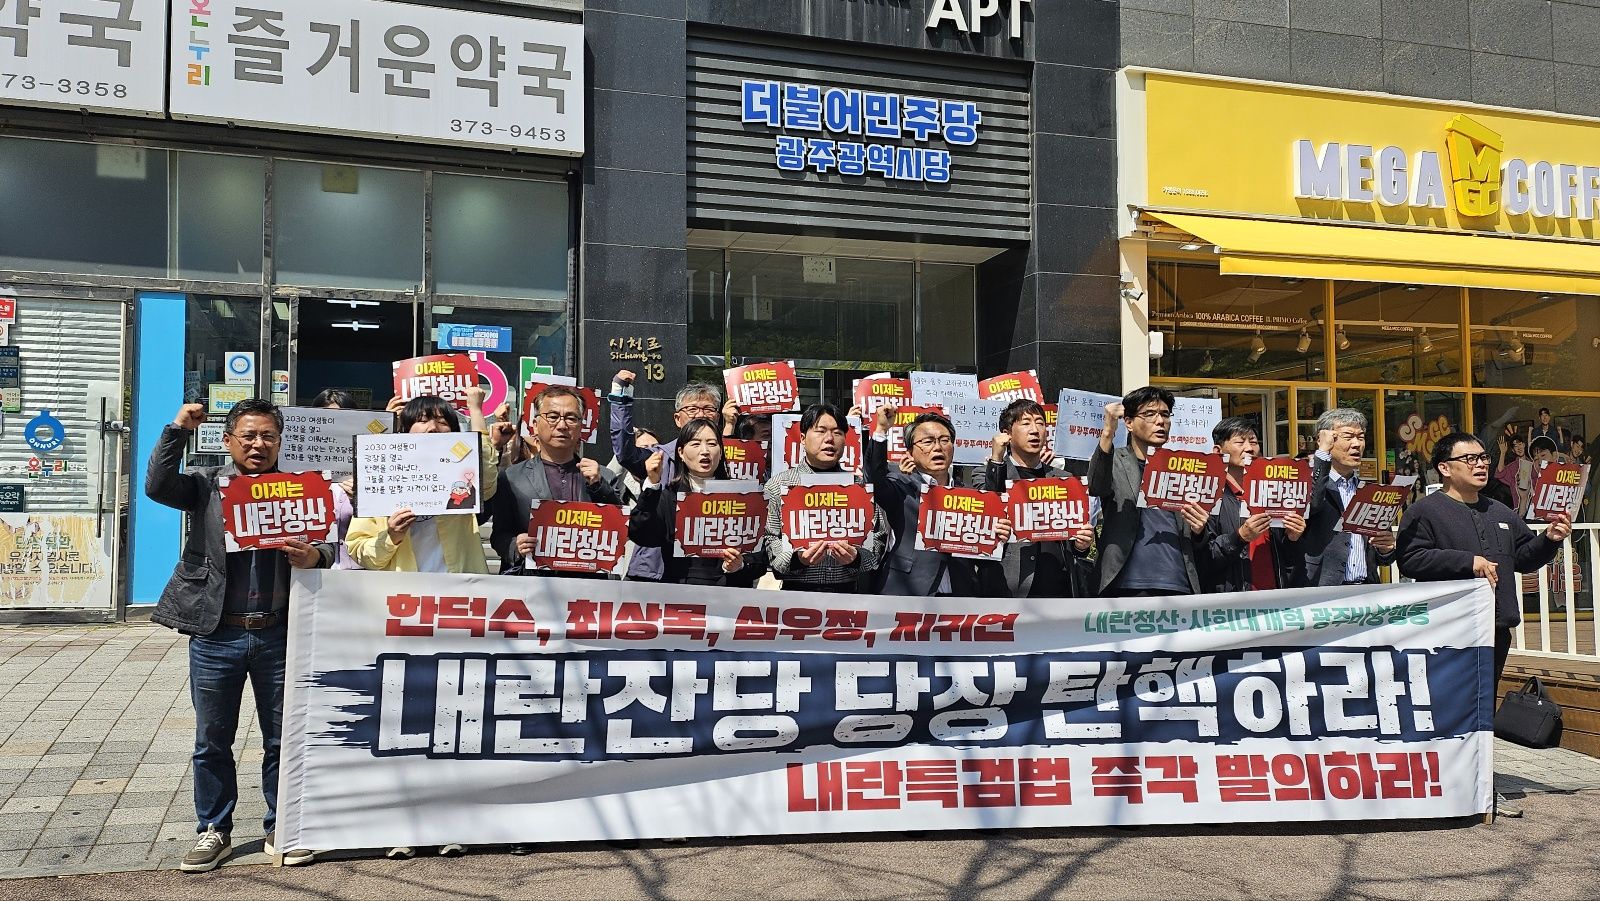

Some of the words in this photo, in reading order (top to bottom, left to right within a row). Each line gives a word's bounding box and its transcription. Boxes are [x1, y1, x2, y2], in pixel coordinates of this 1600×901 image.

[925, 0, 1033, 38] APT
[741, 80, 982, 145] 더불어민주당
[450, 119, 567, 143] 373-9453
[775, 136, 951, 183] 광주광역시당
[1294, 139, 1447, 208] MEGA
[1194, 312, 1211, 320] 100%
[1212, 312, 1240, 322] ARABICA
[1240, 314, 1264, 323] COFFEE
[415, 360, 455, 375] 이제는
[644, 363, 665, 381] 13
[743, 368, 777, 381] 이제는
[401, 374, 472, 402] 내란청산
[734, 379, 792, 406] 내란청산
[871, 383, 905, 396] 이제는
[988, 378, 1022, 394] 이제는
[1063, 395, 1078, 404] 내란
[951, 404, 966, 415] 내란
[971, 405, 986, 415] 수괴
[285, 415, 306, 423] 2030
[309, 416, 335, 424] 여성들이
[894, 412, 918, 425] 이제
[954, 419, 971, 428] 즉각
[975, 421, 998, 432] 구속하
[285, 425, 306, 433] 광장을
[309, 425, 321, 433] 열고
[29, 438, 60, 450] ONNURI
[284, 444, 304, 452] 그들을
[364, 443, 386, 451] 2030
[389, 442, 417, 452] 여성들이
[1168, 435, 1208, 445] 주여성의전화
[284, 453, 304, 461] 변화를
[324, 455, 345, 463] 자격이
[364, 453, 386, 462] 광장을
[389, 454, 403, 462] 열고
[724, 445, 747, 461] 제는
[28, 457, 68, 478] 온누리
[364, 464, 386, 473] 탄핵을
[389, 463, 421, 472] 이뤄냈다.
[1168, 456, 1208, 474] 이제는
[1265, 465, 1299, 480] 이제는
[387, 474, 408, 483] 지우는
[411, 473, 439, 482] 민주당은
[1556, 469, 1581, 485] 이제는
[251, 480, 304, 499] 이제는
[364, 485, 385, 494] 변화를
[406, 485, 429, 493] 자격이
[431, 484, 449, 493] 없다.
[1027, 485, 1068, 500] 이제는
[1147, 470, 1219, 504] 내란청산
[1249, 480, 1308, 509] 내란청산
[804, 491, 849, 508] 이제는
[943, 494, 985, 513] 이제는
[1371, 490, 1402, 504] 이제는
[701, 499, 747, 515] 이제는
[233, 497, 327, 538] 내란청산
[555, 508, 603, 528] 이제는
[1013, 500, 1084, 532] 내란청산
[1345, 501, 1400, 530] 내란청
[683, 516, 761, 547] 내란청산
[789, 508, 866, 540] 내란청산
[925, 509, 999, 545] 내란청산
[534, 525, 619, 561] 내란청산
[30, 563, 42, 574] 수
[48, 562, 97, 574] 있습니다.
[385, 593, 551, 647] 한덕수,
[566, 599, 720, 648] 최상목,
[733, 606, 876, 647] 심우정,
[889, 611, 1020, 642] 지귀연
[1084, 606, 1306, 635] 내란청산·사회대개혁
[377, 657, 812, 755] 내란잔당
[832, 658, 1028, 743] 당장
[1042, 654, 1220, 740] 탄핵
[1227, 651, 1436, 738] 하라!
[786, 756, 1072, 814] 내란특검법
[1090, 755, 1200, 805] 즉각
[1217, 751, 1443, 803] 발의하라!
